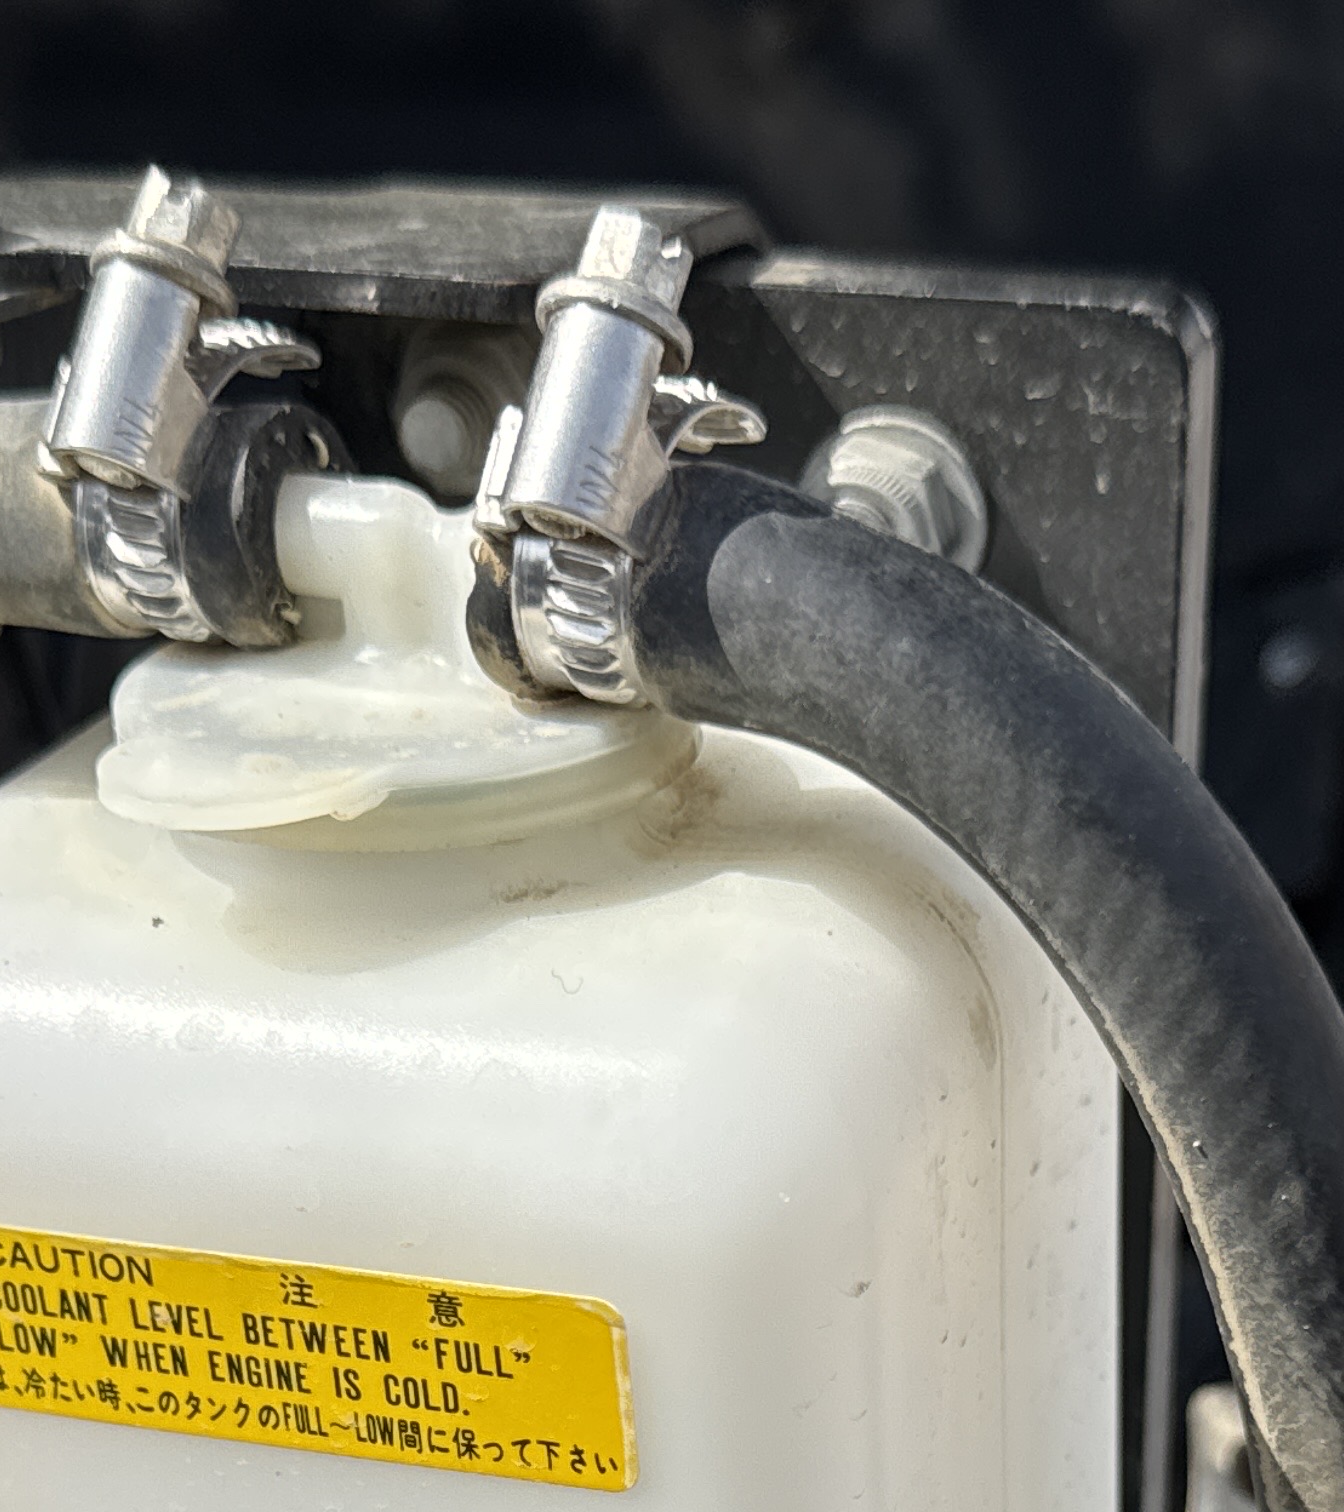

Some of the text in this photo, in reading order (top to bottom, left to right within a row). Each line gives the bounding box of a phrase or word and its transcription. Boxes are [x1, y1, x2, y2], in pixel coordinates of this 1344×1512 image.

[100, 1335, 189, 1377] WHEN
[209, 1351, 312, 1394] ENGINE
[333, 1366, 362, 1401] IS
[383, 1374, 470, 1416] COLD.
[129, 1298, 224, 1341] LEVEL
[242, 1312, 391, 1363] BETWEEN
[412, 1337, 531, 1379] “FULL”
